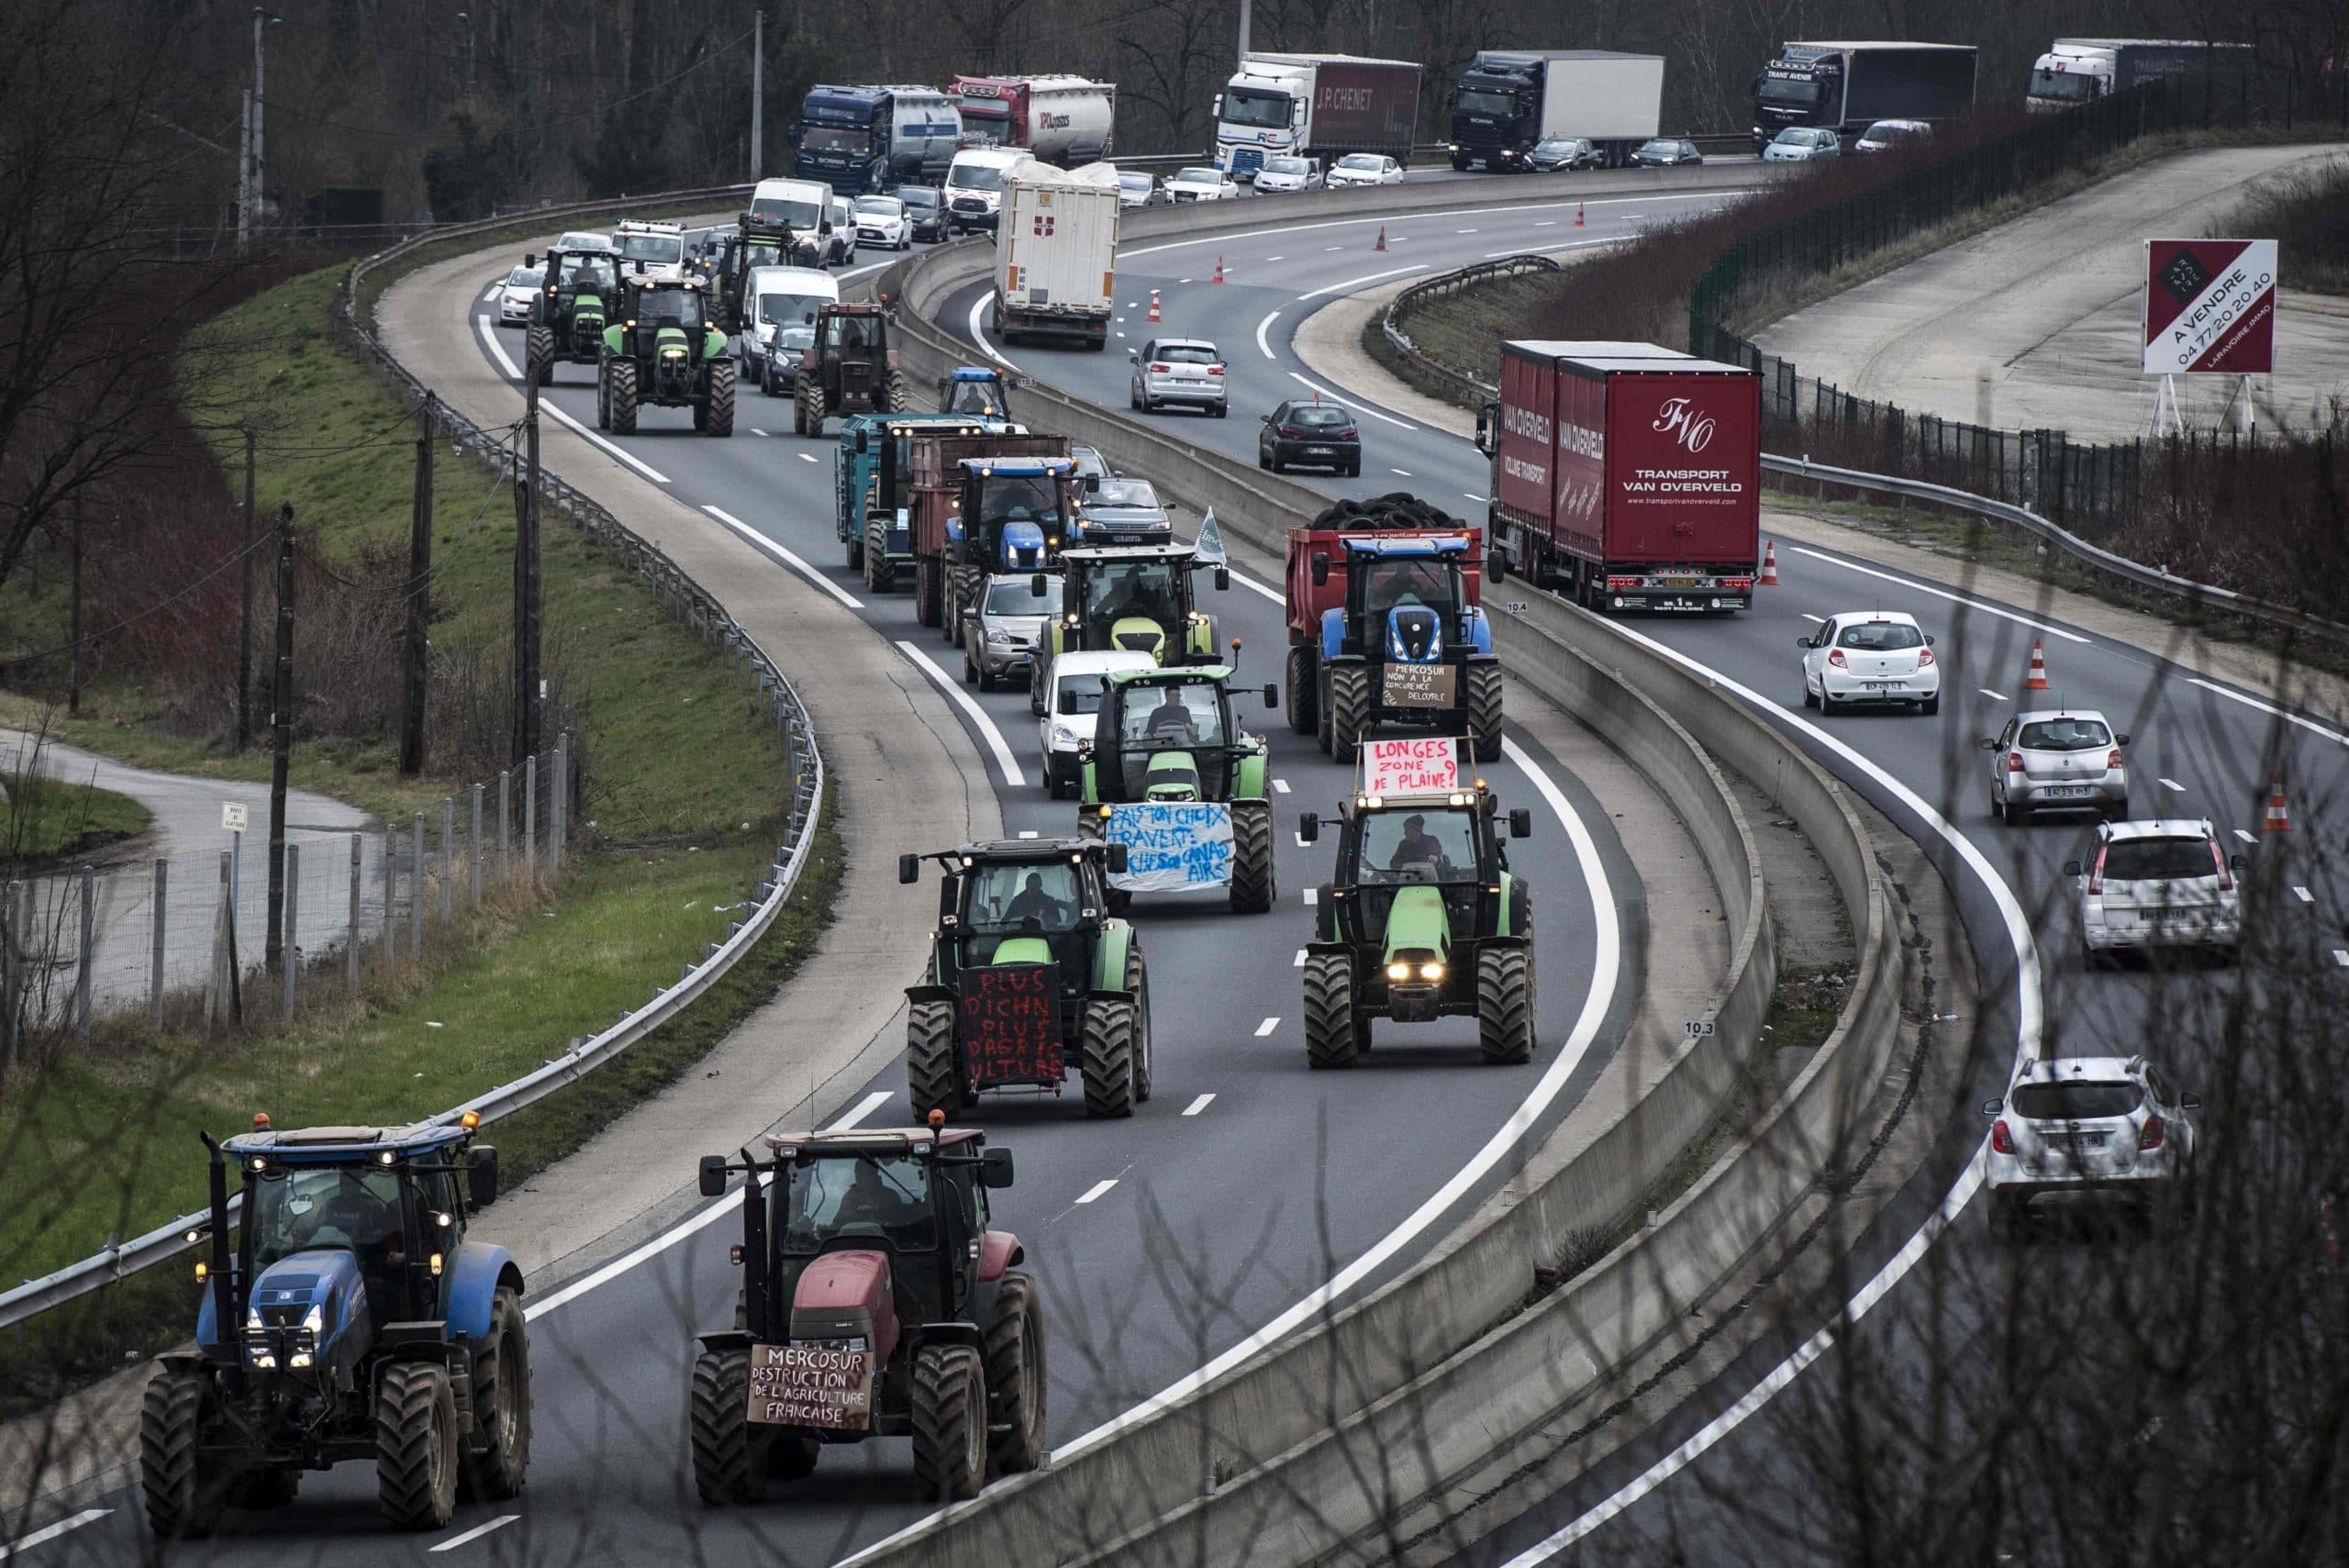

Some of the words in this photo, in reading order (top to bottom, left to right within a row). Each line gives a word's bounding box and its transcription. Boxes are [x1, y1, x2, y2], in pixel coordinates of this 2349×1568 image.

[1789, 72, 1812, 81] AVENIR
[1333, 88, 1374, 111] CHENET
[2174, 330, 2187, 344] A
[2184, 268, 2247, 329] VENDRE
[2178, 345, 2198, 364] 04
[2195, 328, 2212, 346] 77
[2213, 310, 2232, 330] 20
[2232, 292, 2252, 312] 20
[2254, 272, 2271, 293] 40
[2207, 304, 2271, 368] LARAVOIRE.IMMO
[1517, 407, 1550, 445] OVERVELD
[1572, 425, 1603, 461] OVERVELD
[1635, 469, 1730, 480] TRANSPORT
[1622, 482, 1655, 492] VAN
[1660, 483, 1742, 493] OVERVELD
[1508, 603, 1527, 611] 10.4
[1386, 673, 1405, 681] NON
[1396, 664, 1444, 676] MERCOSUR
[1386, 682, 1431, 691] CONCURENCE
[1374, 740, 1449, 759] LONGES
[1379, 760, 1424, 773] ZONE
[1374, 777, 1387, 791] DE
[1110, 806, 1146, 829] FAIS
[1147, 806, 1171, 825] TON
[1175, 804, 1228, 828] CHOIX
[1187, 862, 1228, 883] AIRS
[980, 969, 1044, 994] PLUS
[982, 1019, 1051, 1040] PLUS
[1686, 1021, 1713, 1034] 10.3
[768, 1349, 862, 1372] MERCOSUR
[752, 1367, 846, 1387] DESTRUCTION
[755, 1385, 768, 1396] DE
[772, 1386, 865, 1406] L'AGRICULTURE
[766, 1403, 843, 1423] FRANCAISE
